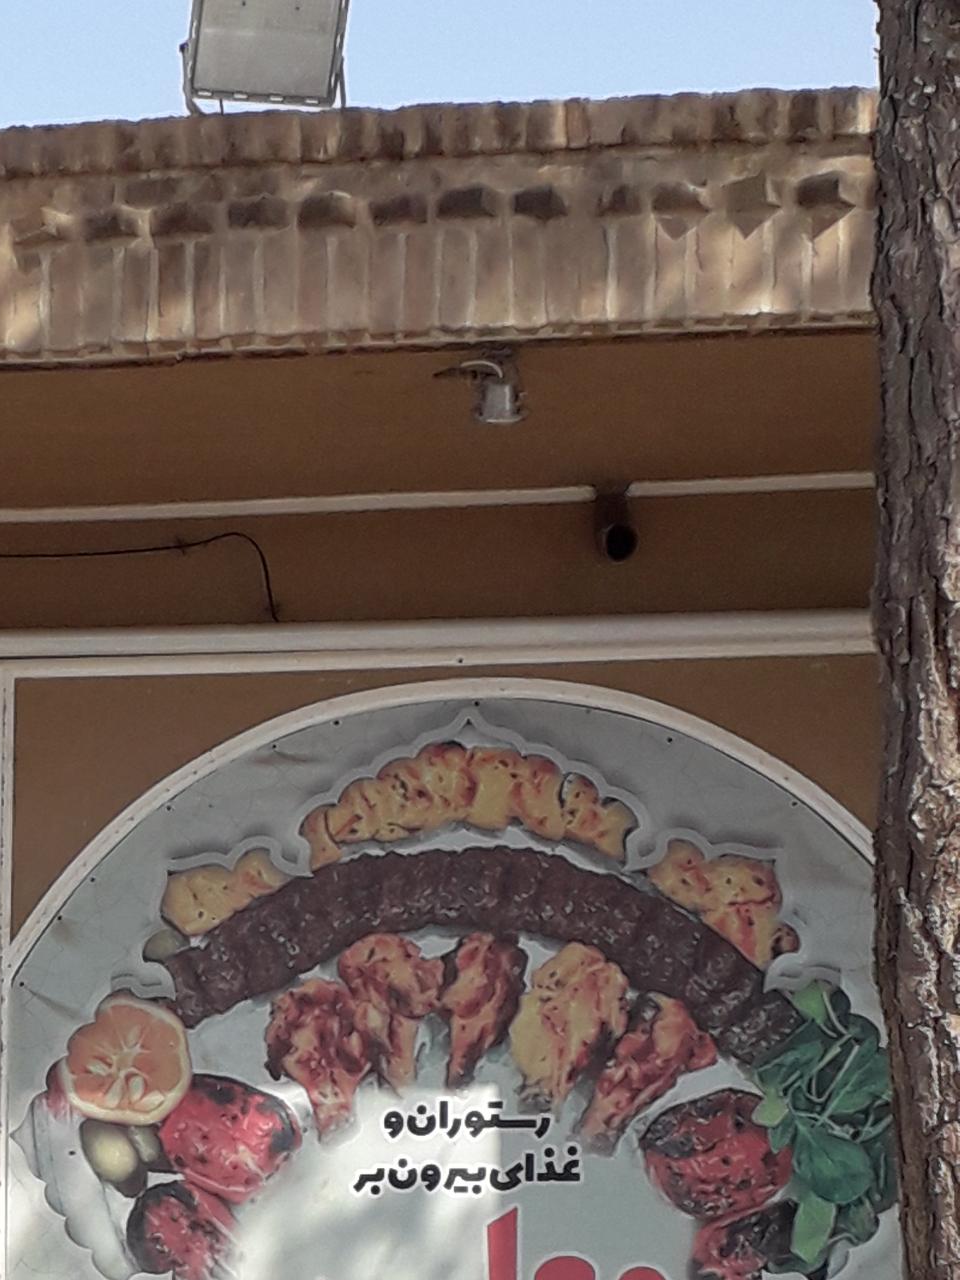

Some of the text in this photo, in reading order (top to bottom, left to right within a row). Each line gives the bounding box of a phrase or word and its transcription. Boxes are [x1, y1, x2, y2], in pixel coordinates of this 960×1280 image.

[383, 1100, 551, 1138] رستوران و
[489, 1146, 581, 1191] غذای
